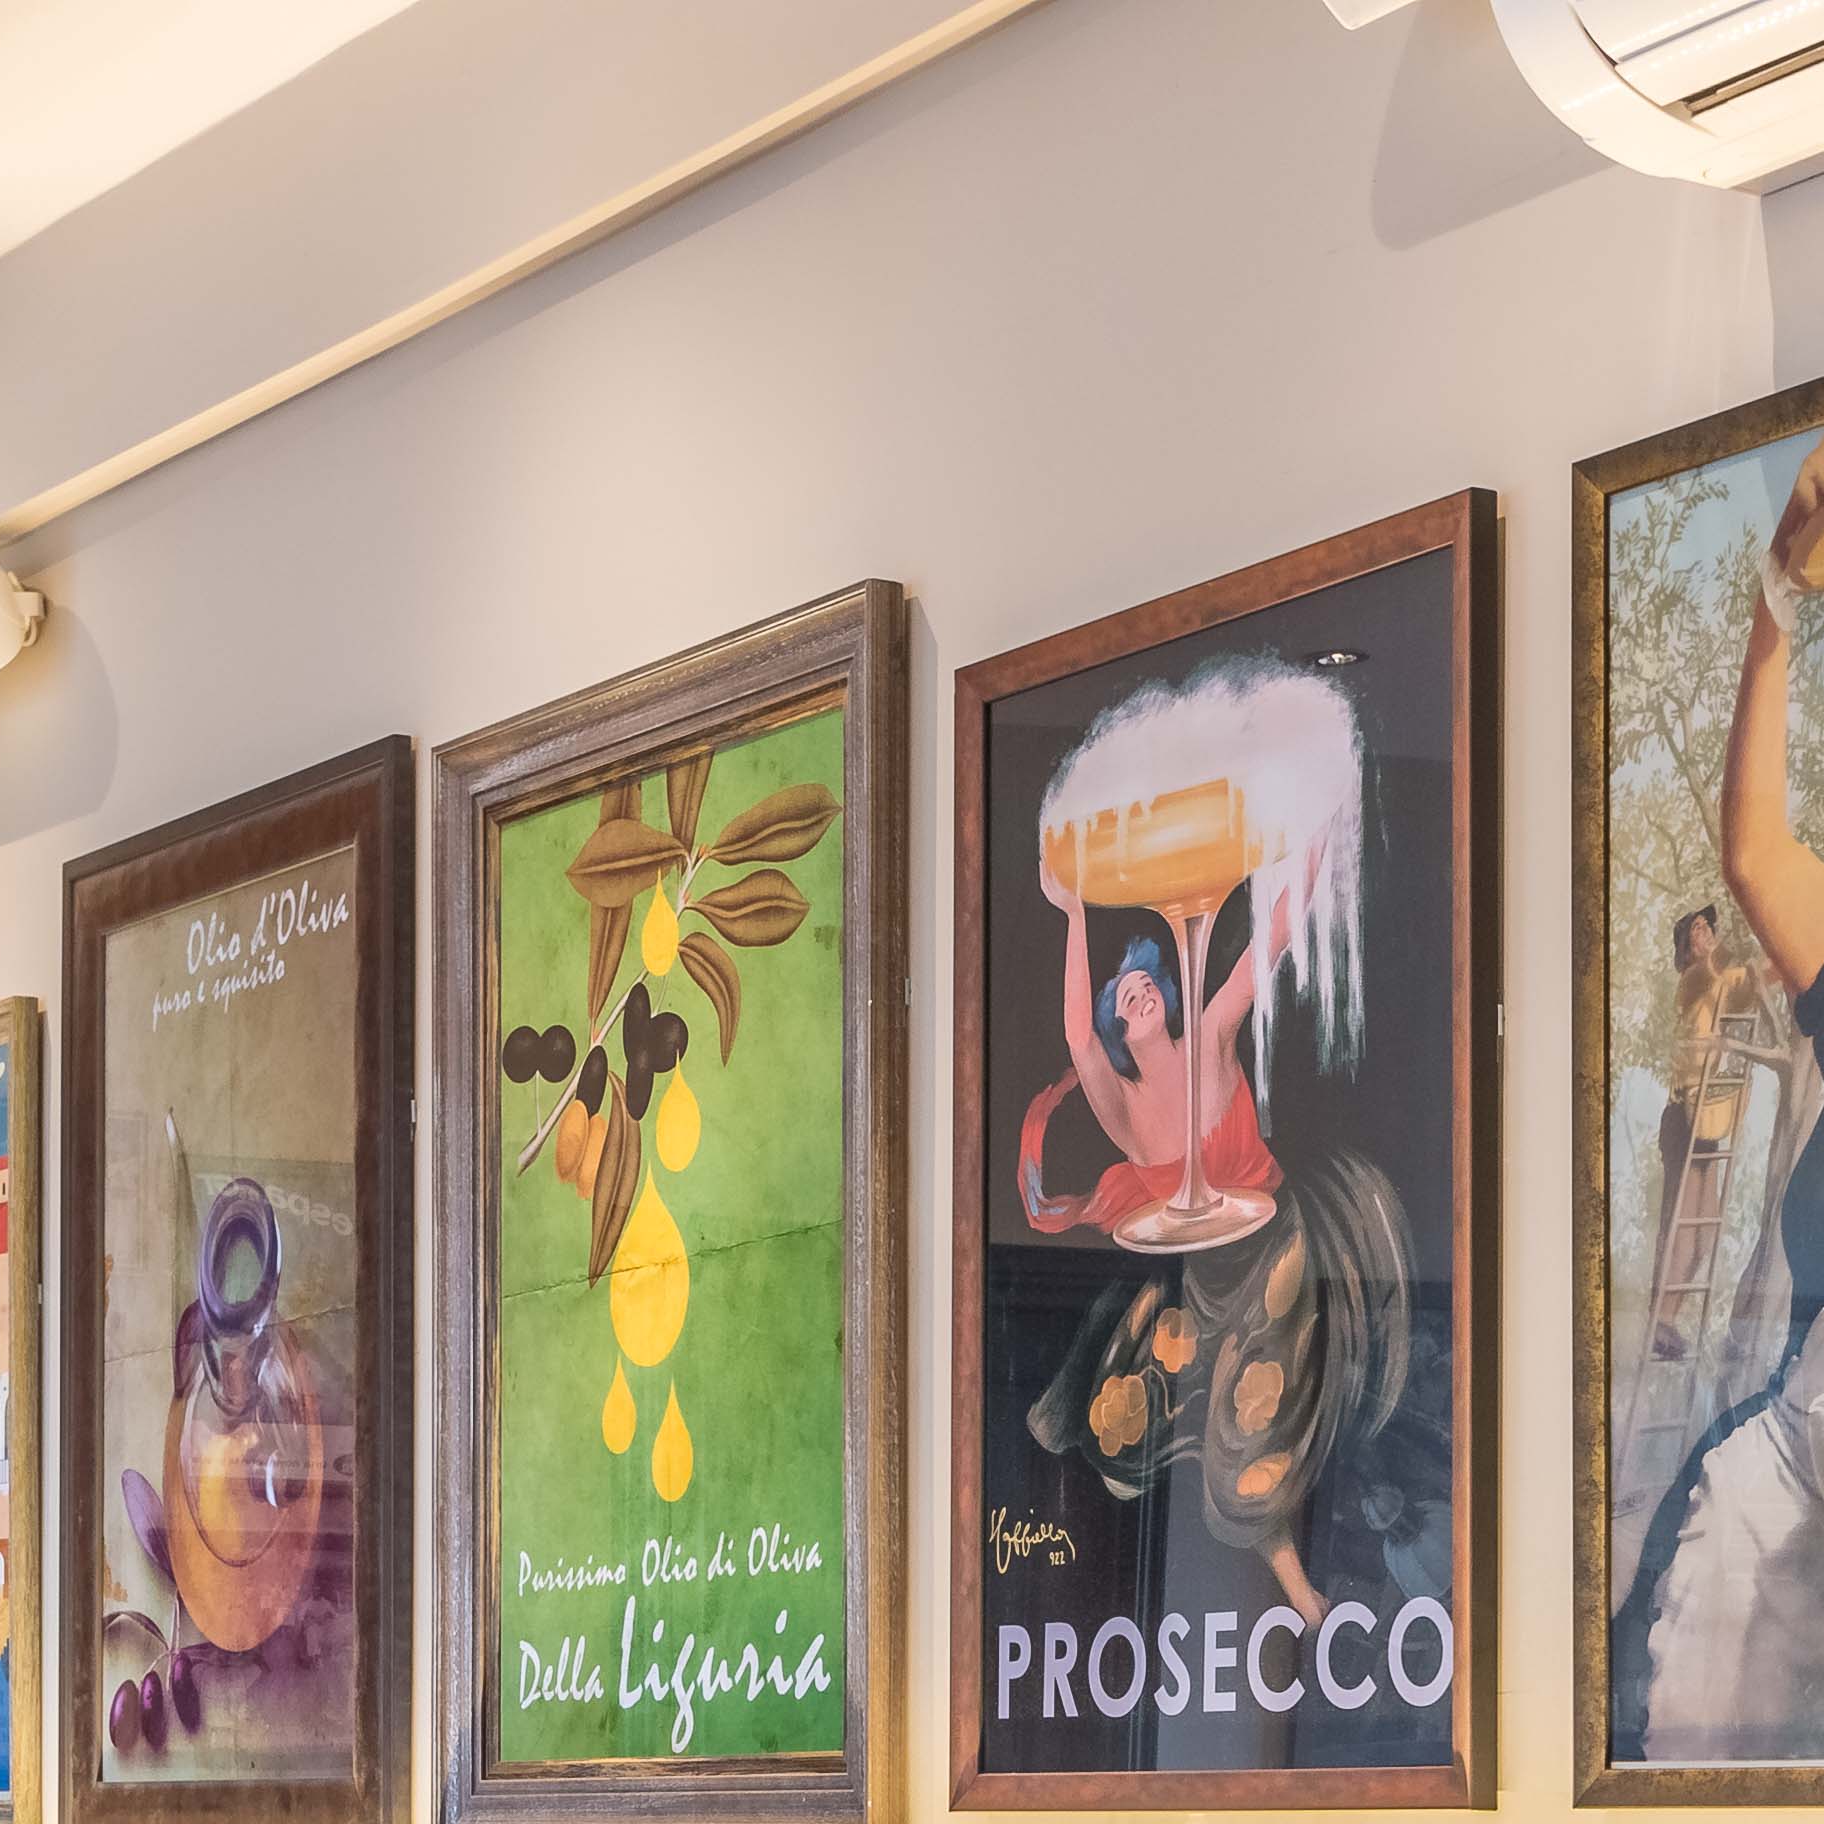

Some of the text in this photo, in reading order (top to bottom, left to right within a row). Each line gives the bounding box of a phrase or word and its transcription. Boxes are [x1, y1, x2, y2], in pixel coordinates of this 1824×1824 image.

[187, 879, 349, 975] Olio d'Oliva
[152, 991, 191, 1032] puro
[211, 950, 286, 1014] squisito
[518, 1522, 823, 1597] Purissimo Olio di Oliva
[519, 1595, 832, 1753] Della Liguria
[997, 1595, 1453, 1719] PROSECCO
